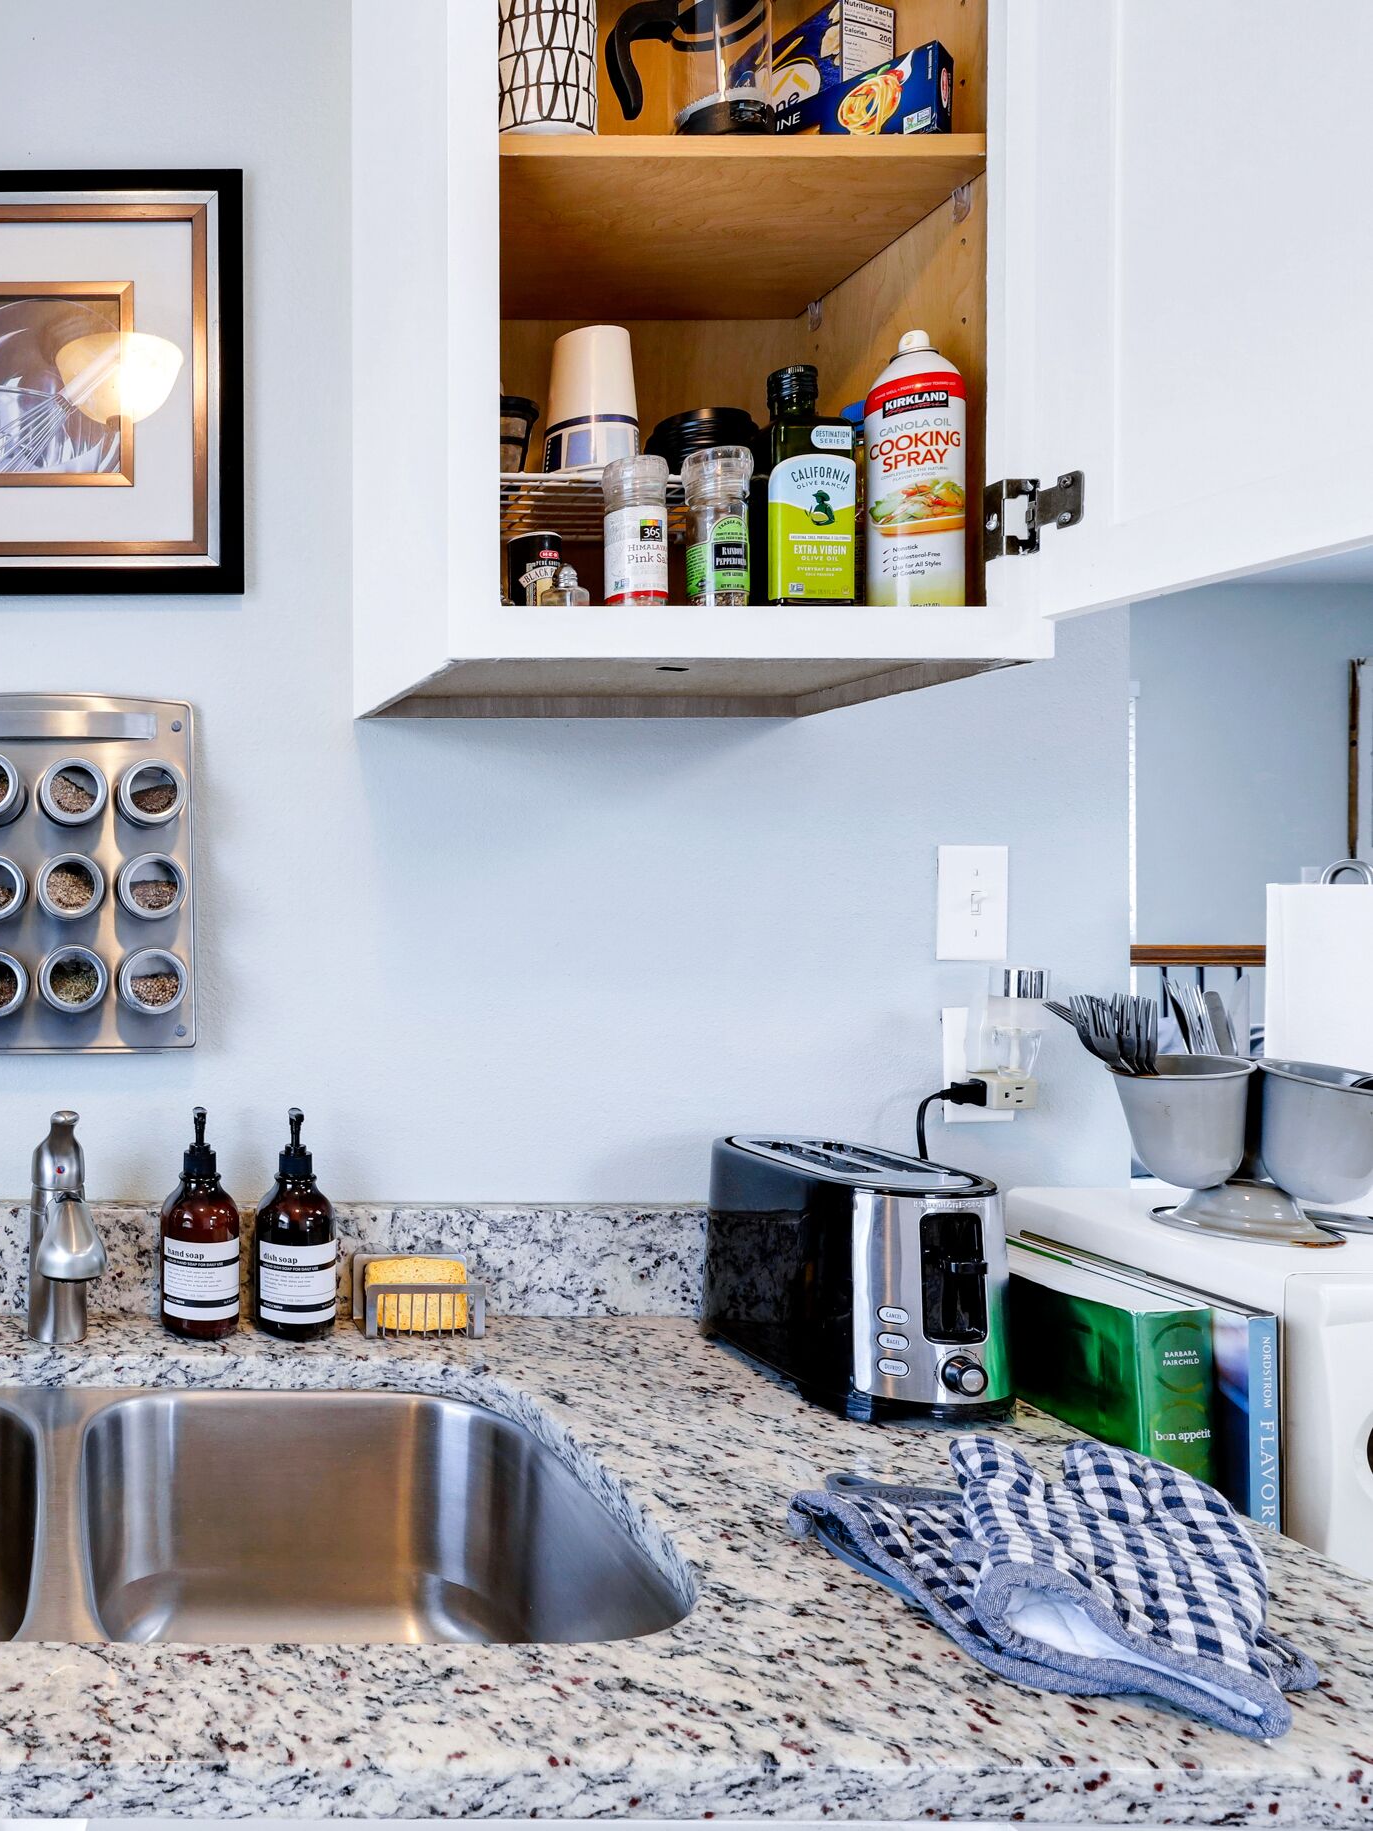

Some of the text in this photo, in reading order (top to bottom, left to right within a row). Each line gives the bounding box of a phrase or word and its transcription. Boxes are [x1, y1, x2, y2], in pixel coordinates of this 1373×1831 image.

[875, 7, 893, 18] Facts
[844, 26, 868, 37] Calories
[879, 33, 893, 44] 200
[885, 391, 947, 411] KIRKLAND
[879, 418, 952, 437] CANOLA OIL
[815, 430, 850, 438] DESTINATION
[869, 430, 961, 460] COOKING
[882, 448, 948, 473] SPRAY
[790, 466, 851, 485] CALIFORNIA
[796, 480, 846, 491] OLIVE RANCH
[643, 526, 660, 538] 365
[793, 544, 847, 555] EXTRA VIRGIN
[892, 544, 918, 553] Nonstick
[626, 552, 654, 564] Pink
[892, 552, 941, 562] Cholesterol-Free
[523, 567, 549, 584] BLACK
[900, 569, 926, 577] Cooking
[167, 1246, 205, 1261] hand soap
[263, 1252, 298, 1265] dish soap
[1164, 1350, 1197, 1358] BARBARA
[1162, 1358, 1200, 1366] FAIRCHILD
[1262, 1336, 1273, 1408] NORDSTROM
[1155, 1431, 1176, 1441] bon
